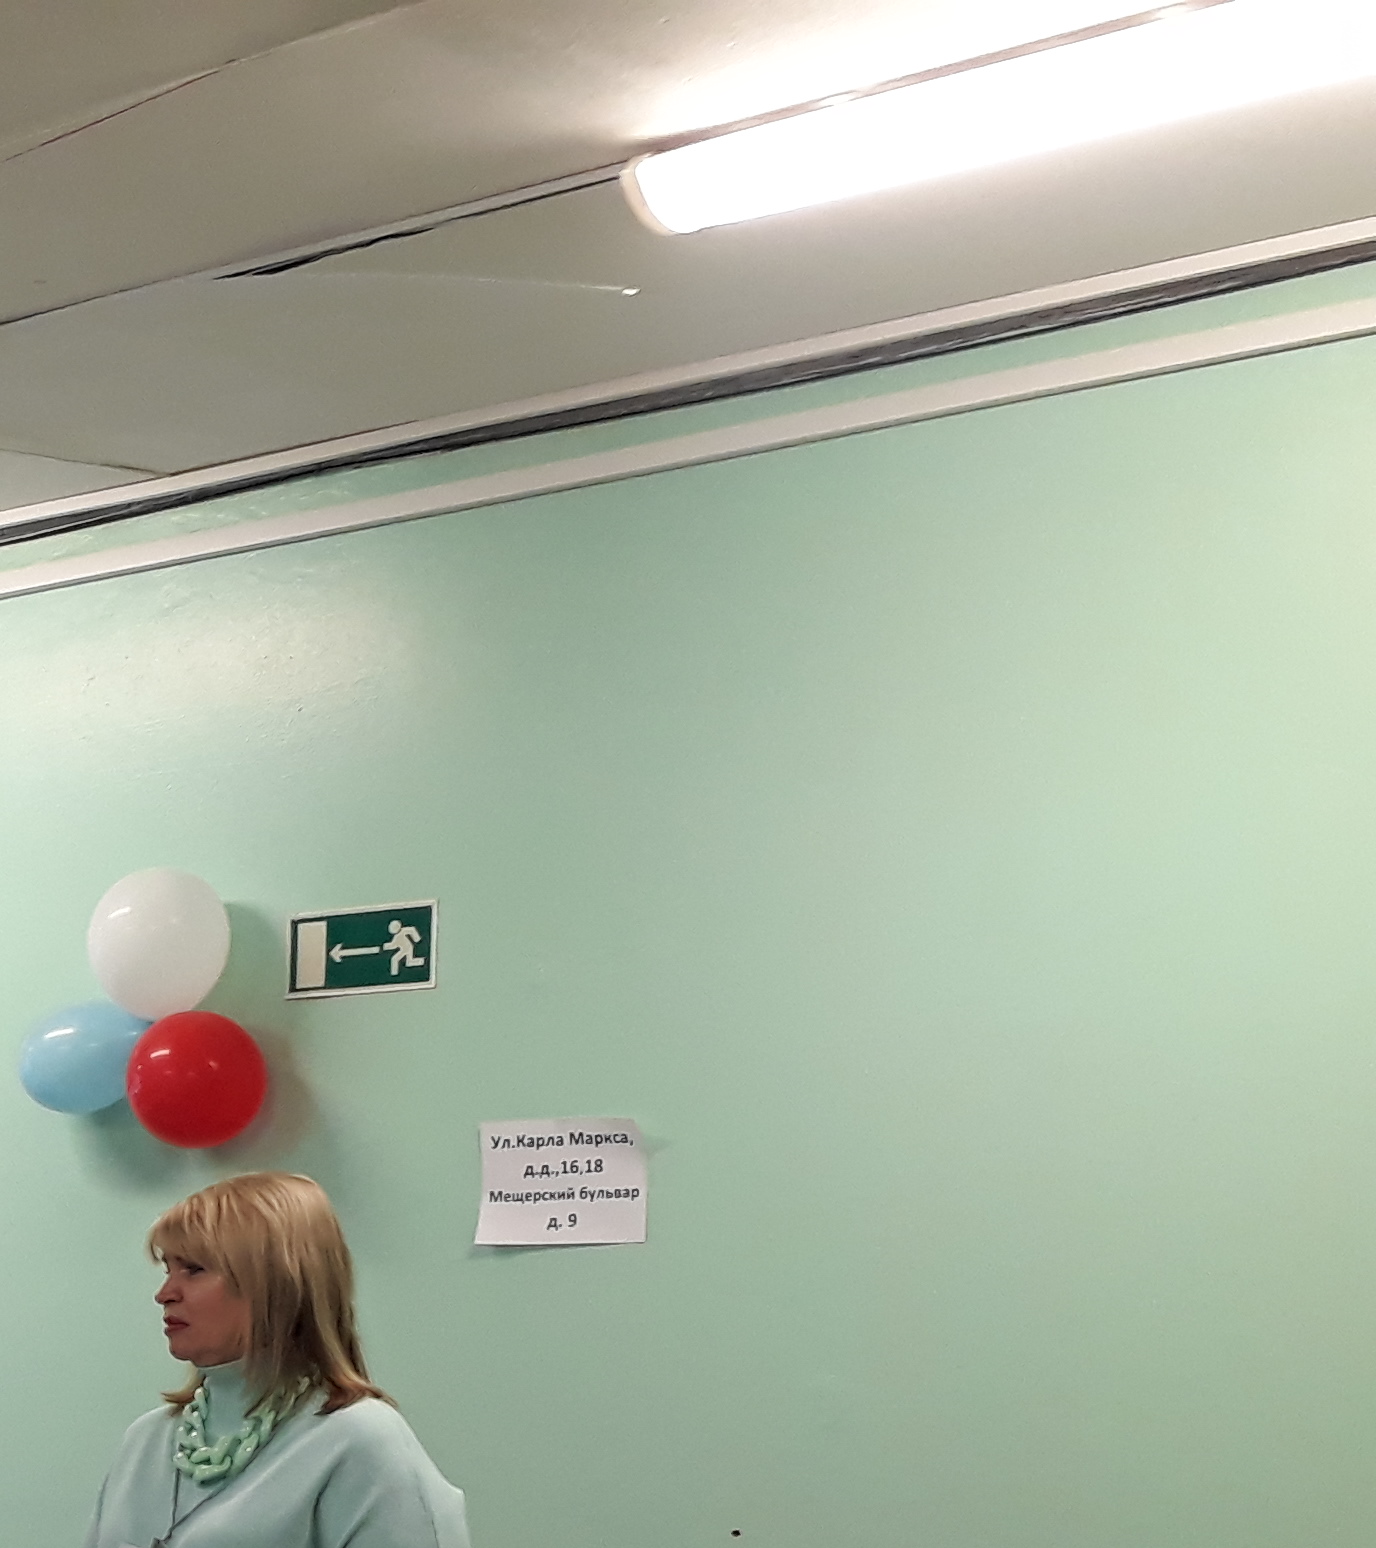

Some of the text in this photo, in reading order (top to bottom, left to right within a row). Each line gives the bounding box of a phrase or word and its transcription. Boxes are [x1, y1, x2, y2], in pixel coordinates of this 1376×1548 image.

[491, 1132, 634, 1151] Ул.Карла Маркса,
[489, 1187, 639, 1204] Мещерский бульвар
[547, 1214, 577, 1231] д. 9
